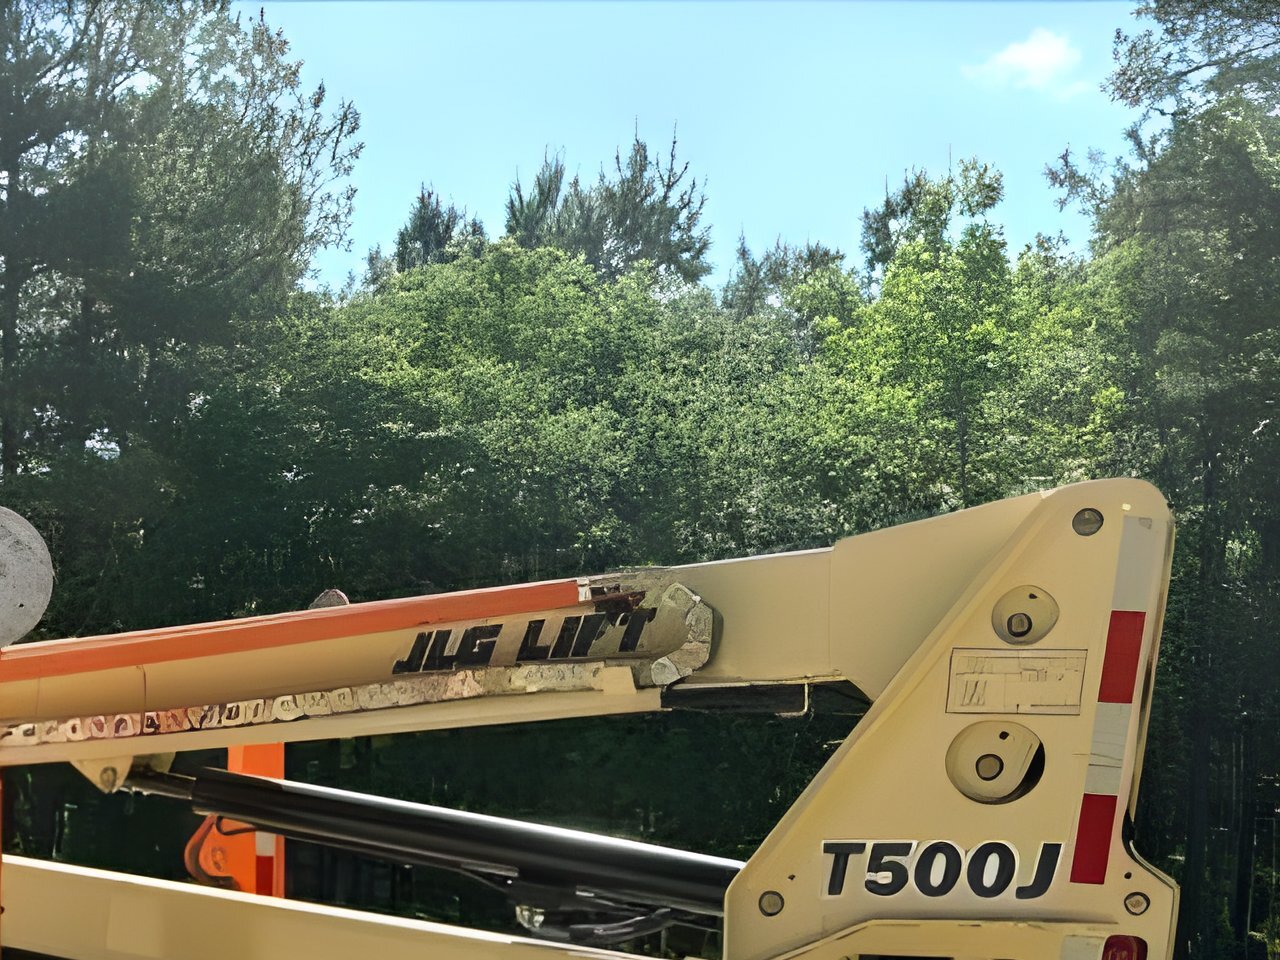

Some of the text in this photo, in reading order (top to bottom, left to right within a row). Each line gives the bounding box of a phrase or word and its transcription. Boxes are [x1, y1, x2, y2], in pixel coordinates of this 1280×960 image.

[392, 607, 656, 674] JLG LIFT
[822, 842, 1063, 899] T500J
